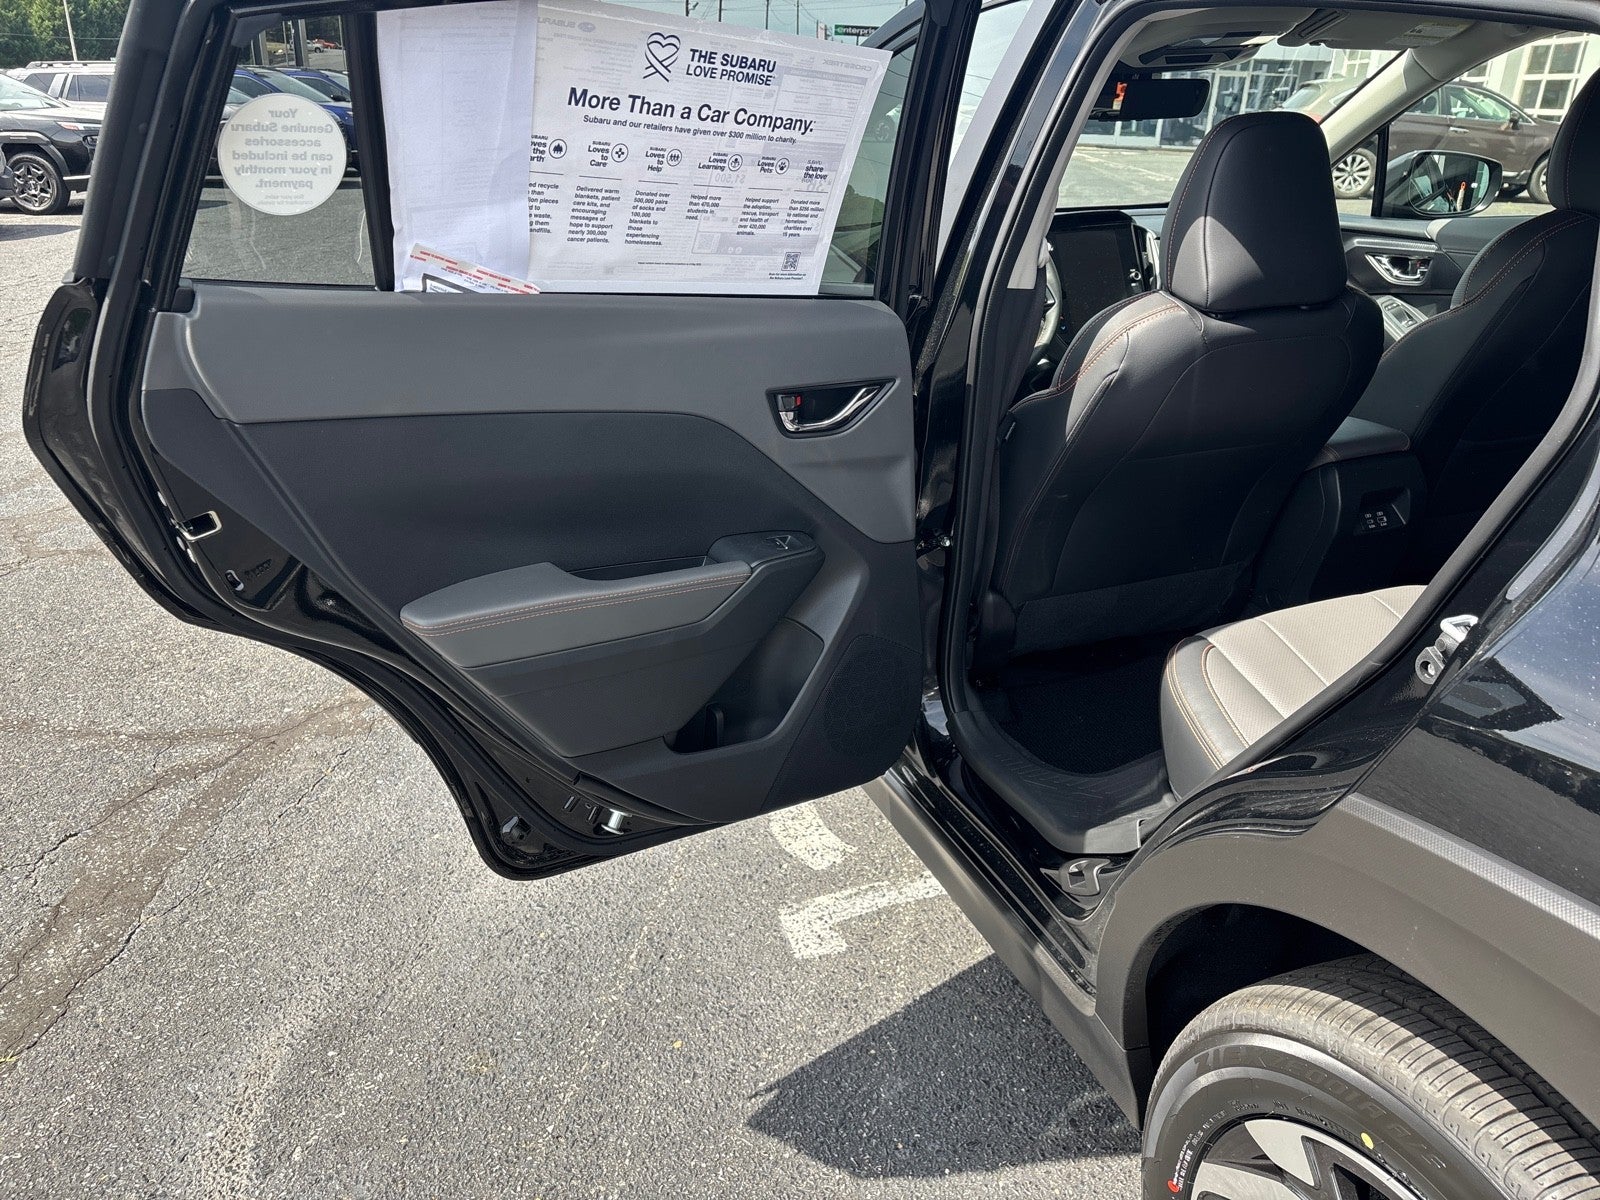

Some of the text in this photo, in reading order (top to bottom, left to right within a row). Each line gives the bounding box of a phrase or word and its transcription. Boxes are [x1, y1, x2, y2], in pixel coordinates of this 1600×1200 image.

[690, 48, 776, 73] THE SUBARU
[686, 64, 718, 79] LOVE
[568, 86, 621, 111] More
[628, 94, 675, 118] Than
[681, 106, 692, 120] a
[697, 104, 730, 124] Car
[583, 115, 797, 145] Subaru and our retailers have given over $300 million to charity.
[532, 147, 546, 156] the
[588, 145, 610, 154] Loves
[601, 154, 609, 162] to
[645, 151, 666, 159] Loves
[589, 159, 608, 168] Care
[708, 156, 727, 164] Loves
[757, 160, 775, 168] Loves
[647, 164, 663, 173] Help
[698, 162, 726, 173] Learning
[760, 166, 774, 174] Pets
[804, 164, 825, 173] share
[803, 171, 828, 180] the love
[576, 185, 604, 194] Delivered
[635, 190, 658, 198] Donated
[539, 197, 559, 205] pieces
[574, 193, 600, 201] blankets,
[571, 207, 607, 216] encouraging
[569, 221, 584, 229] hope
[629, 218, 652, 226] blankets
[568, 229, 585, 237] nearly
[625, 232, 660, 241] experiencing
